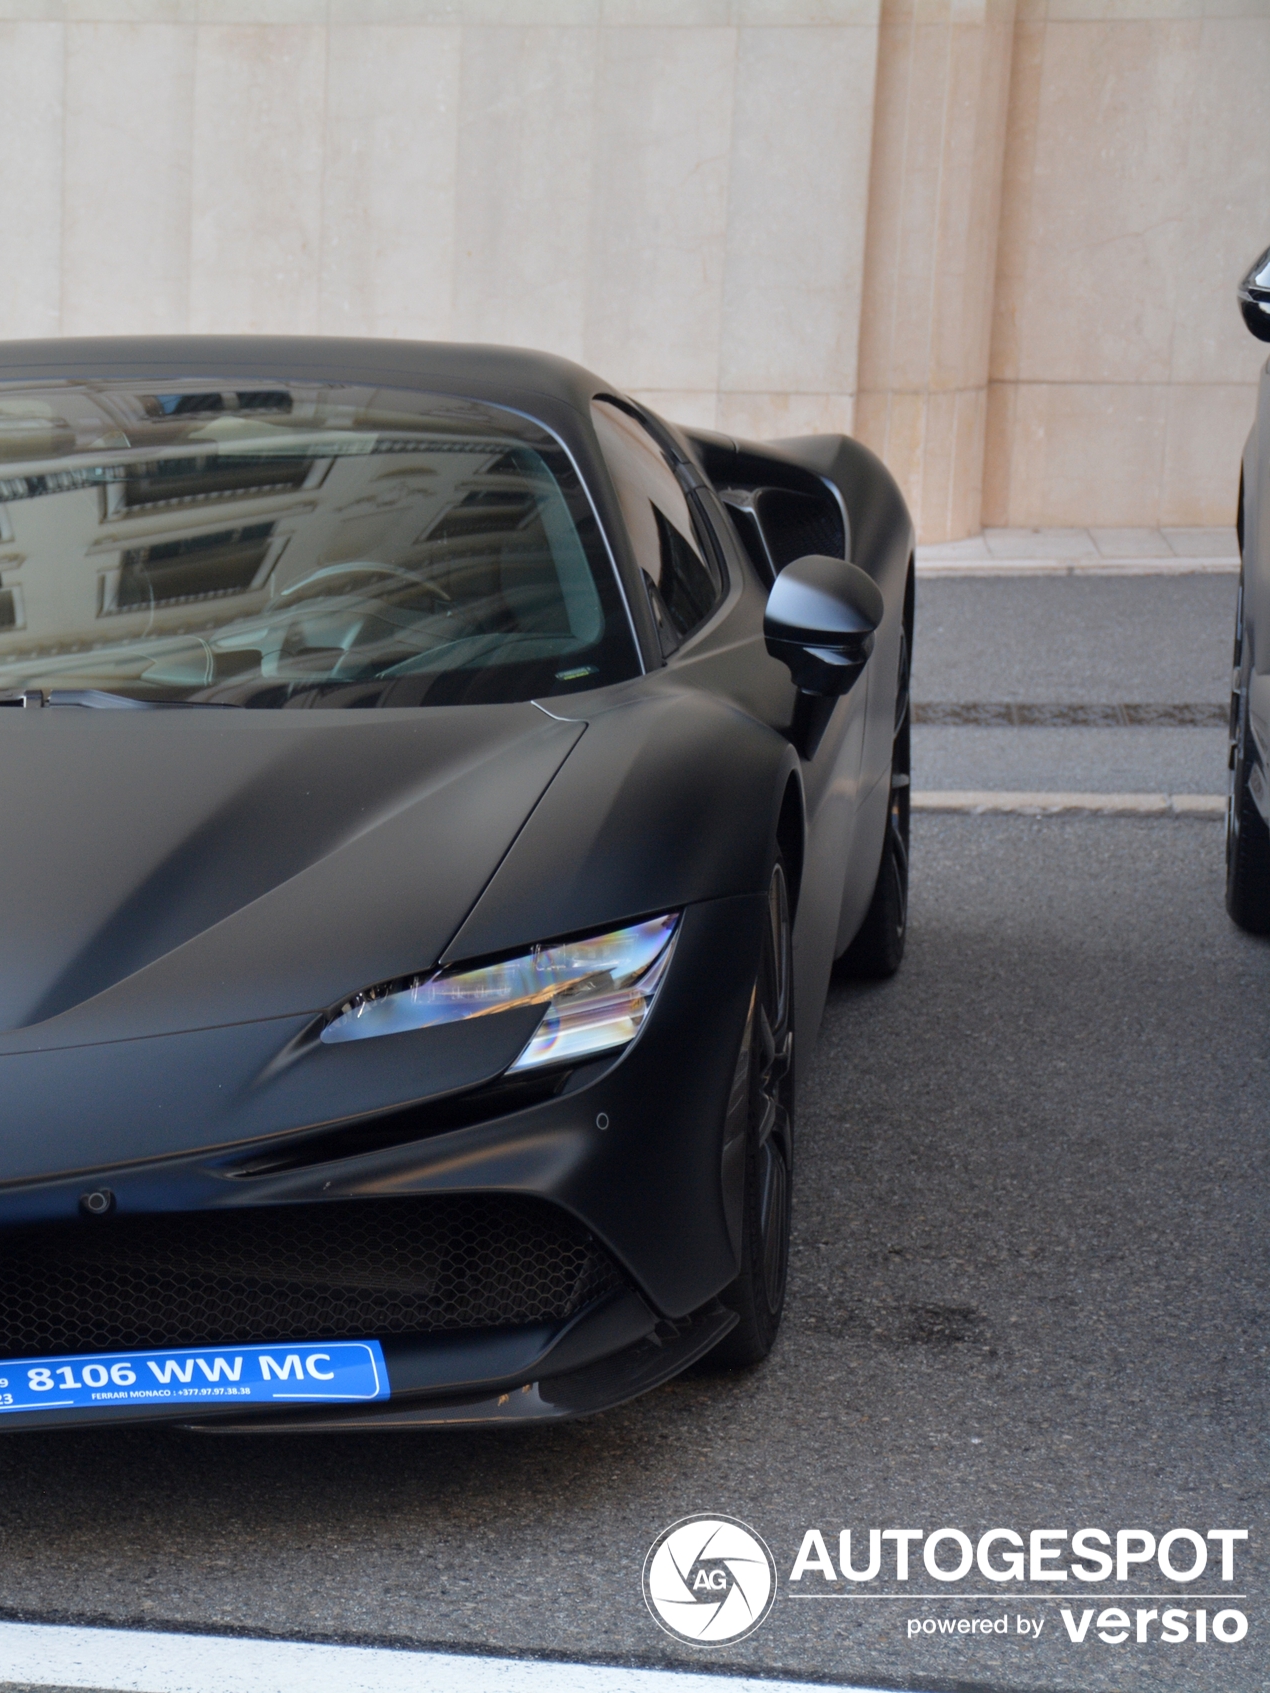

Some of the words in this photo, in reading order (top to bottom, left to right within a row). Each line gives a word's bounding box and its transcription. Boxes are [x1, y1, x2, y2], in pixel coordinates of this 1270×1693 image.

[28, 1363, 136, 1391] 8106
[147, 1358, 243, 1383] WW
[258, 1353, 335, 1381] MC
[91, 1391, 128, 1400] FERRARI
[130, 1389, 171, 1398] MONACO
[178, 1387, 251, 1397] +377.97.97.38.38
